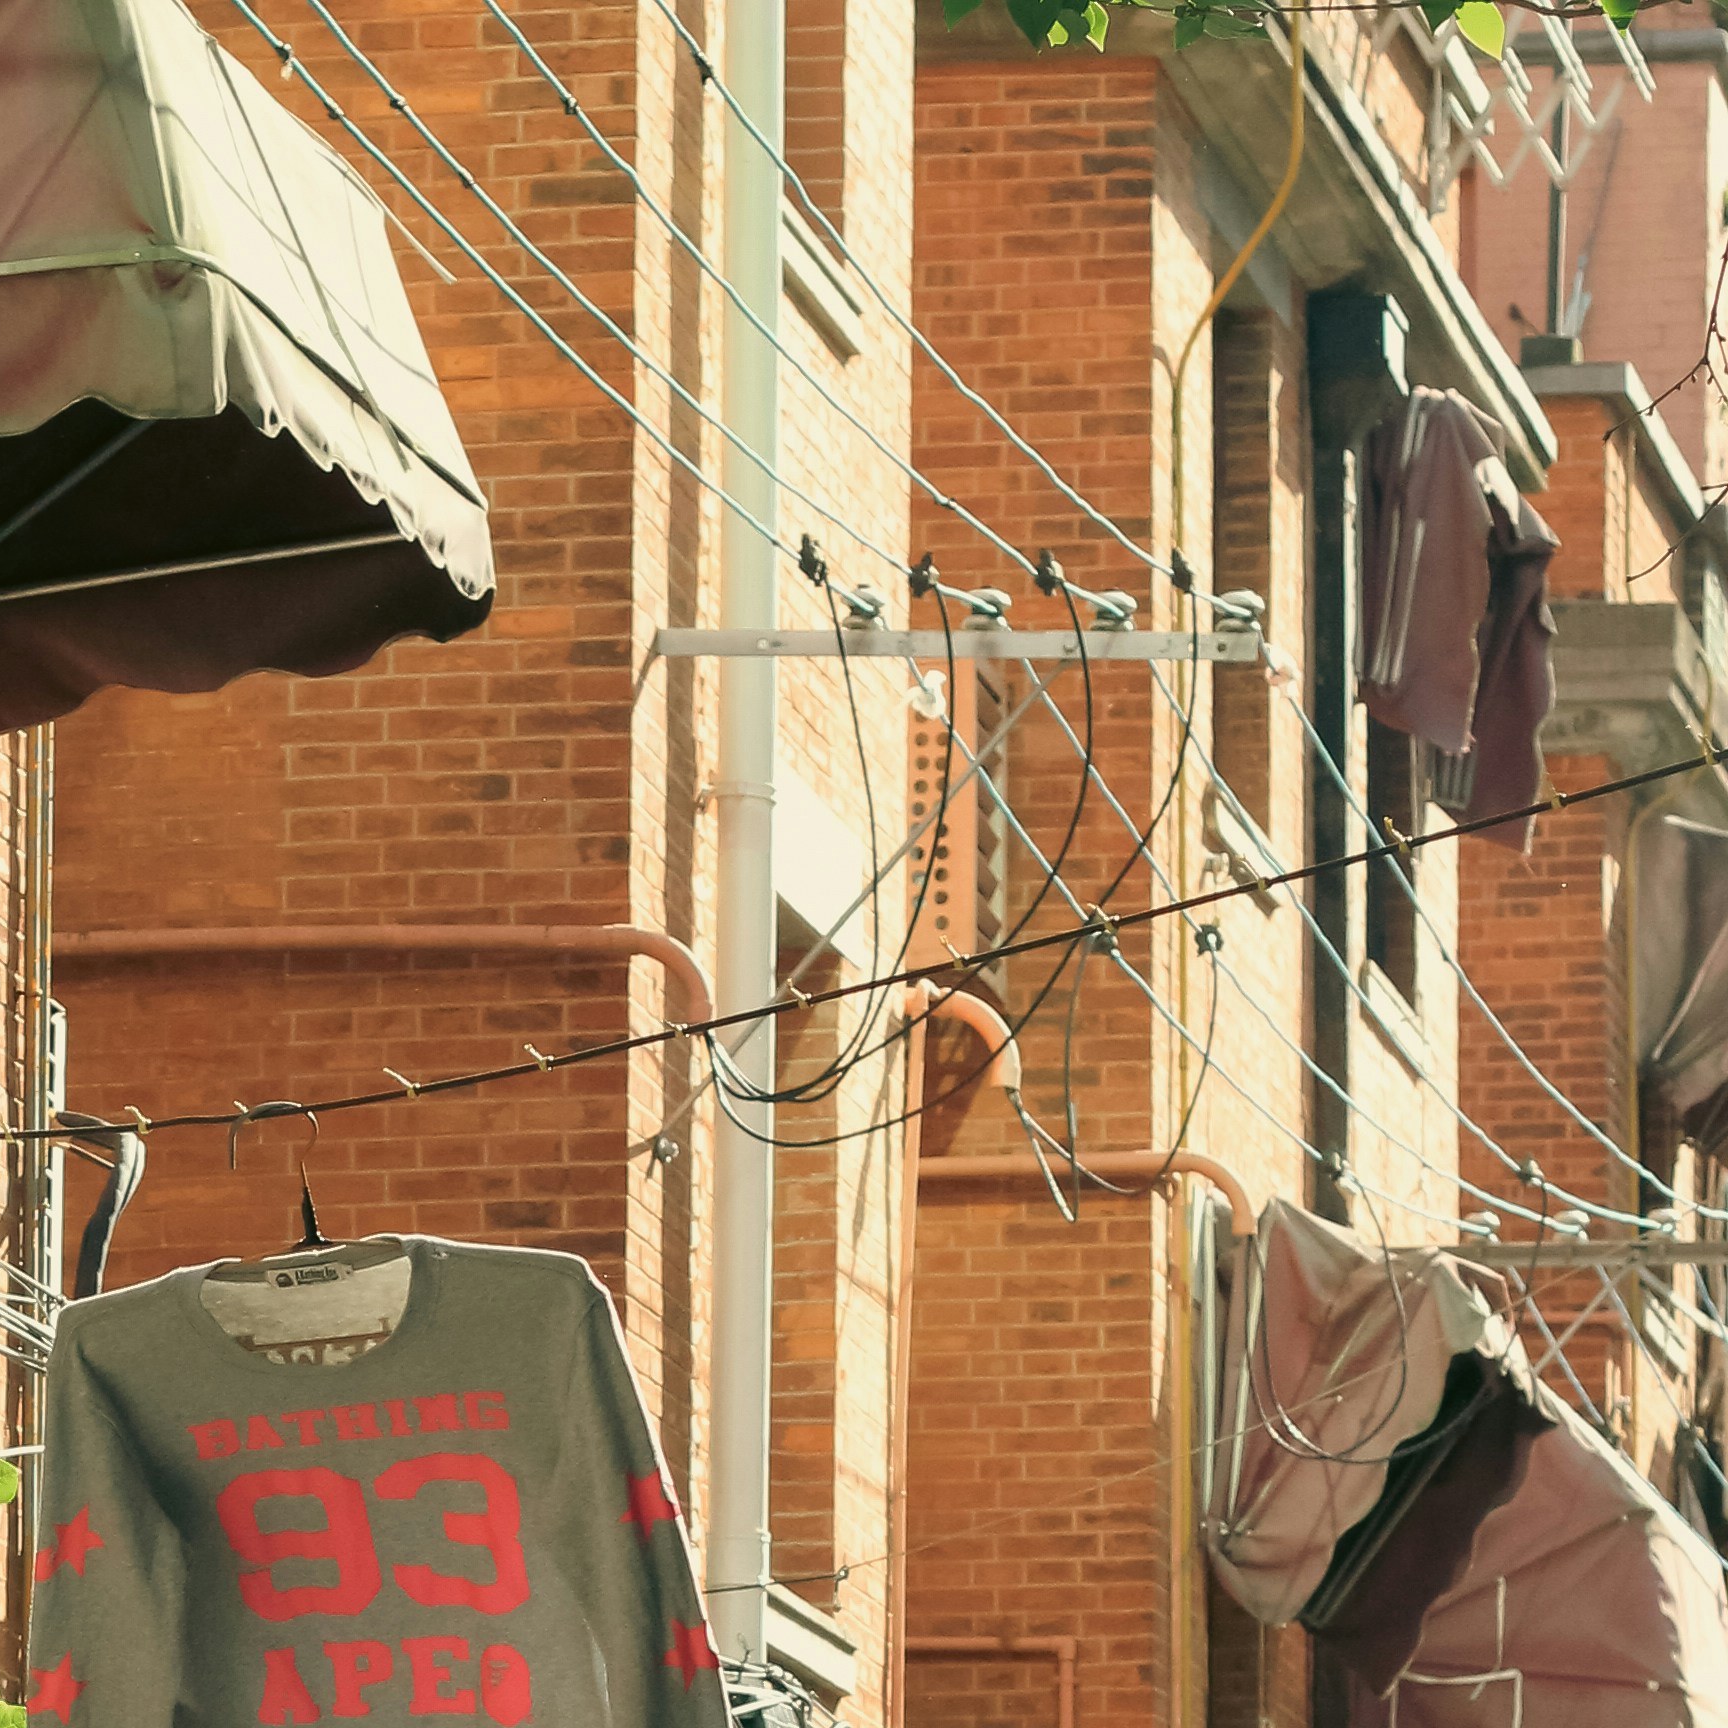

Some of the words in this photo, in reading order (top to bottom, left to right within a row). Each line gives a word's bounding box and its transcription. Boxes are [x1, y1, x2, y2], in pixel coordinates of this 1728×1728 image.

[187, 1391, 510, 1460] BATHING
[216, 1453, 530, 1621] 93
[258, 1636, 476, 1725] APE
